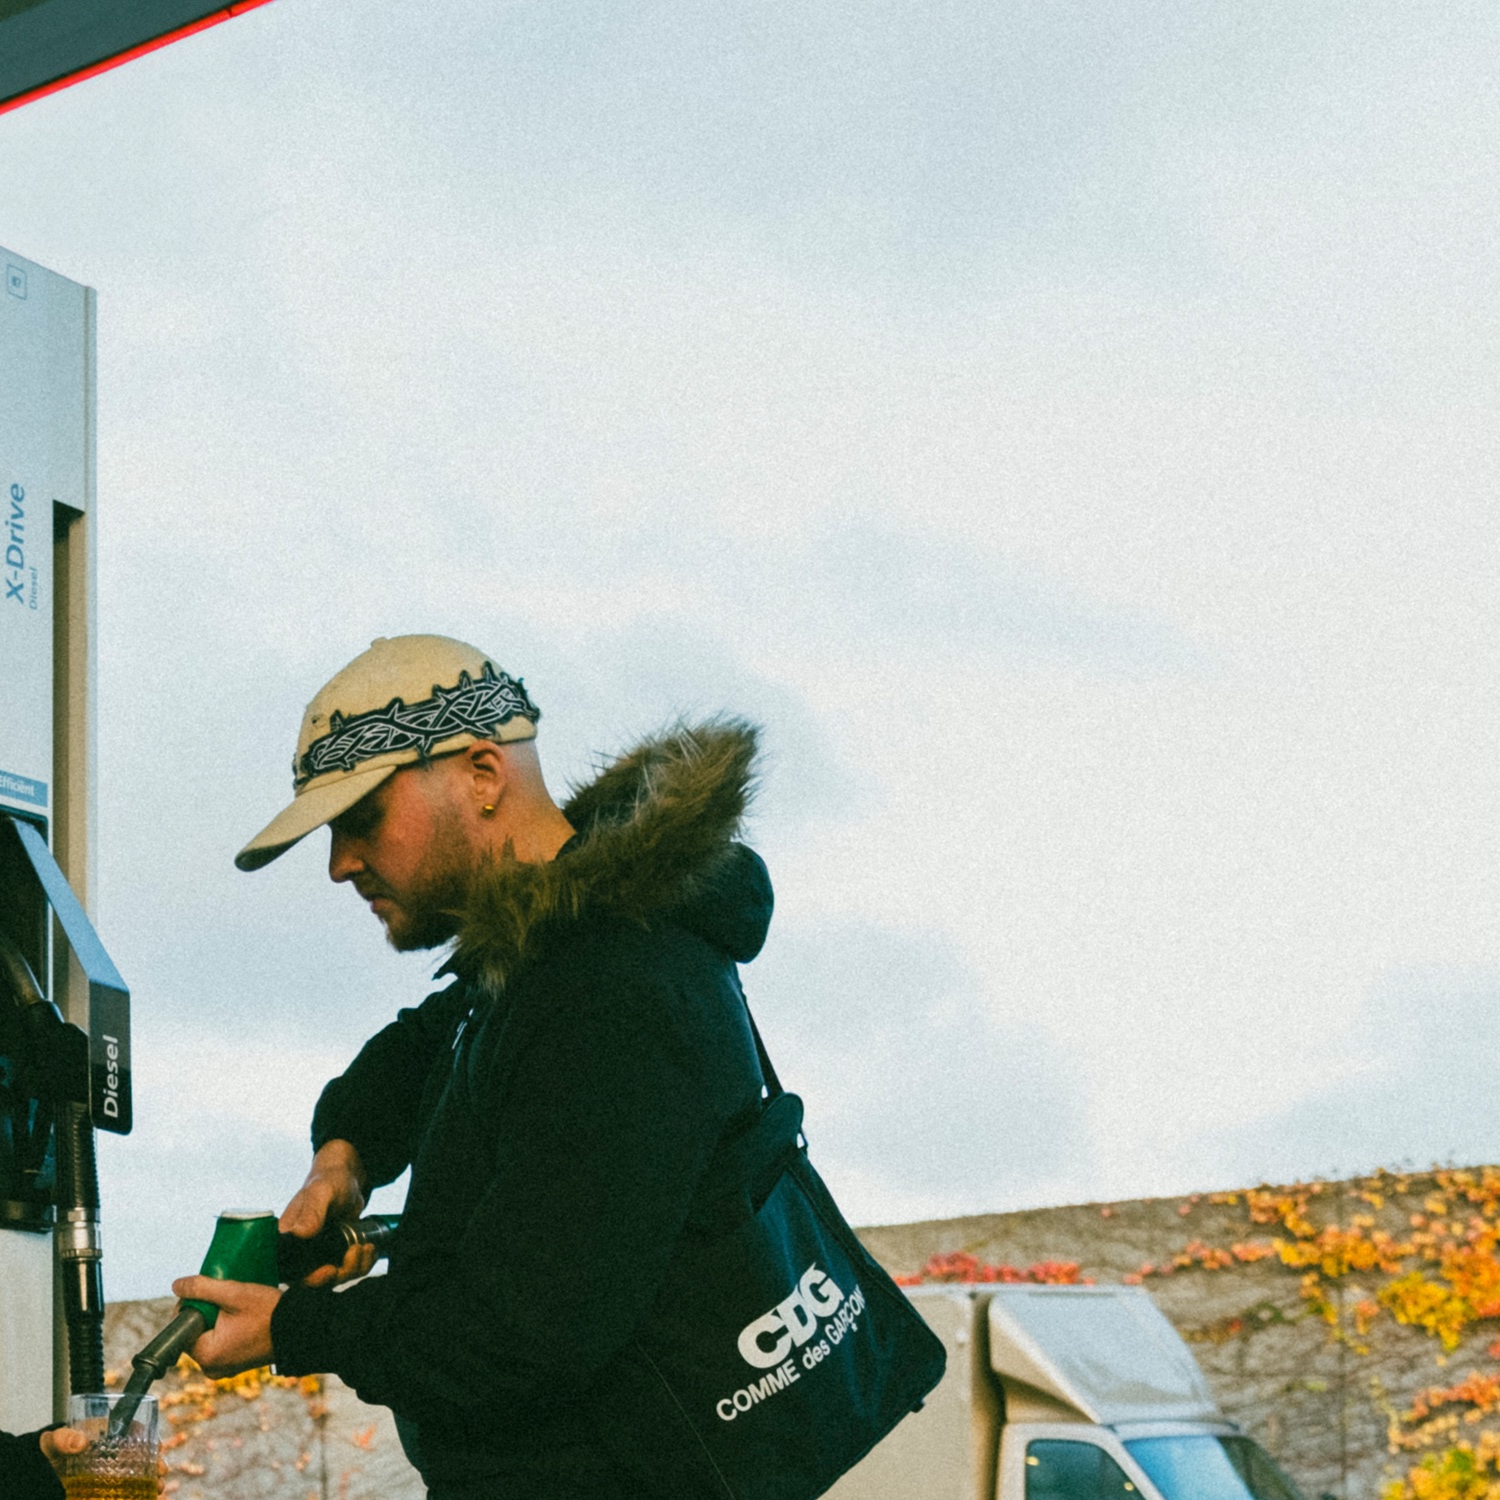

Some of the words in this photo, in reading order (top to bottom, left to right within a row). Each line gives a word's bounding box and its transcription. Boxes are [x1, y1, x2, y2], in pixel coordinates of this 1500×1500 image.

[5, 483, 25, 605] X-Drive
[29, 566, 38, 610] Diesel
[102, 1034, 119, 1118] Diesel
[737, 1262, 845, 1369] CDG
[716, 1358, 800, 1421] COMME
[802, 1339, 831, 1370] des
